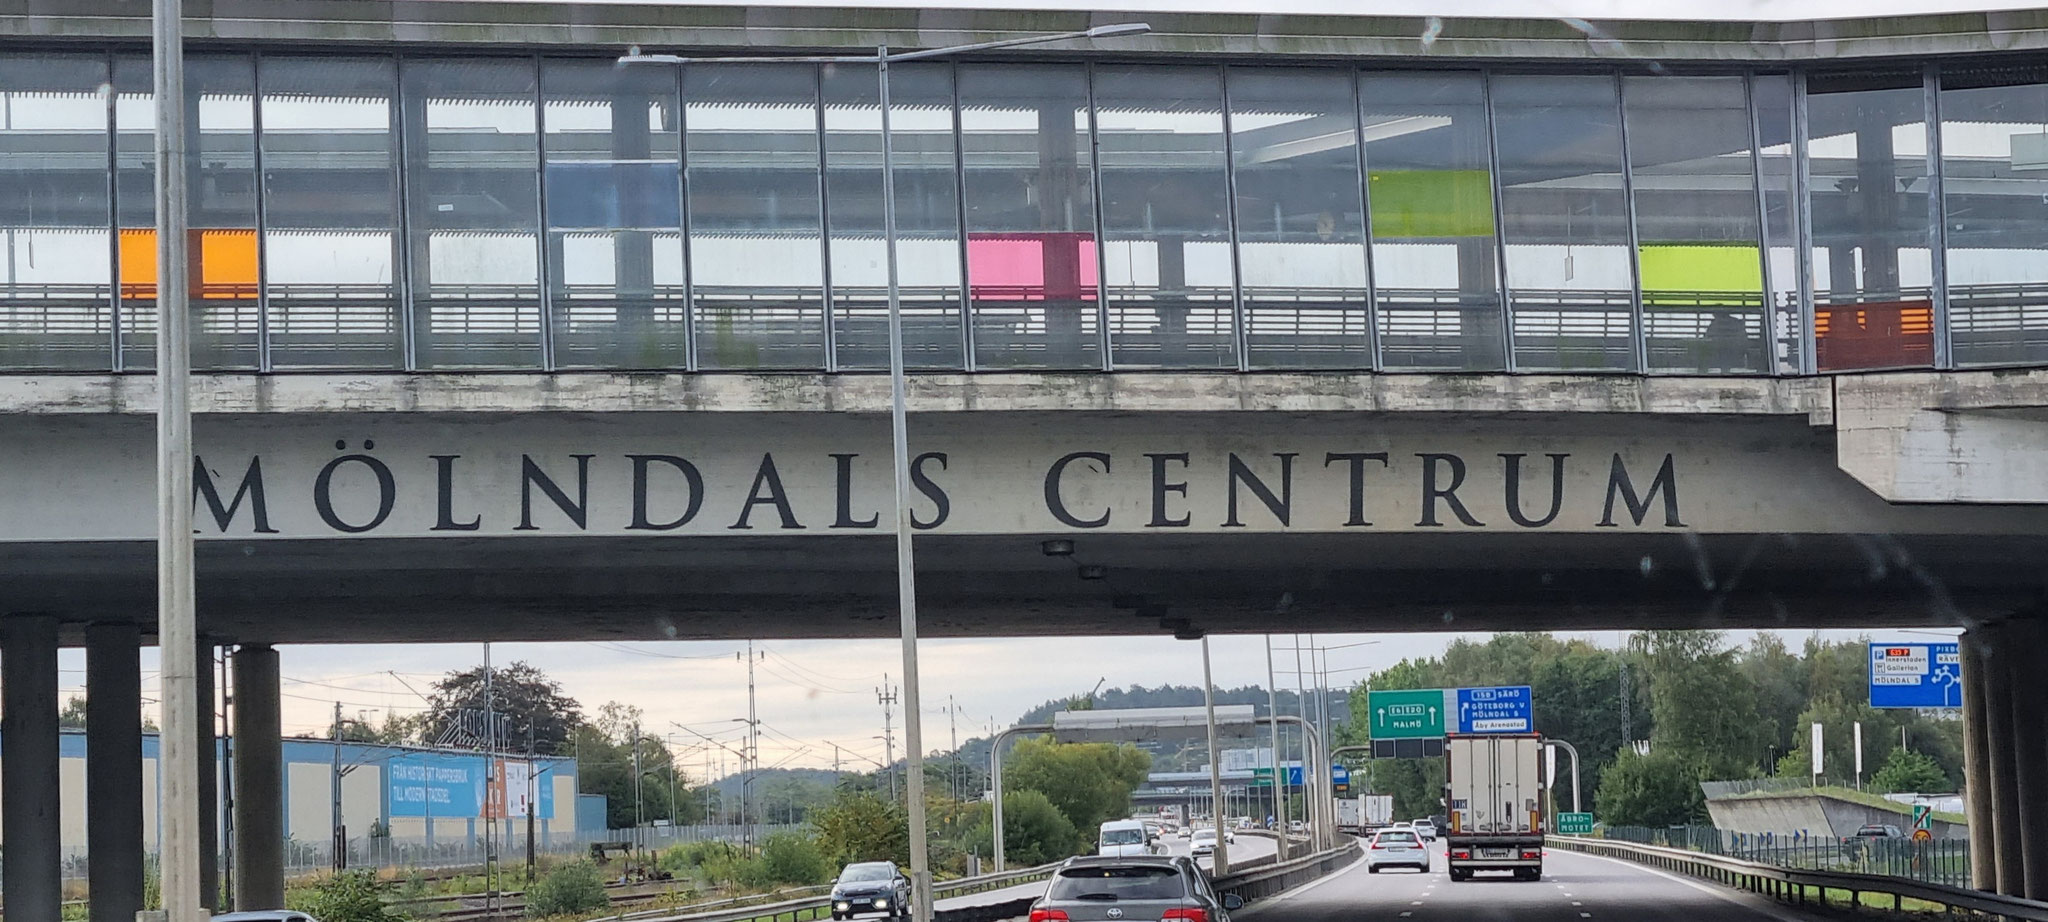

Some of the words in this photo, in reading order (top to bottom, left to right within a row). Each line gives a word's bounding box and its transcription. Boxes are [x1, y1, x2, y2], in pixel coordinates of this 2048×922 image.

[191, 439, 952, 534] MÖLNDALS
[1043, 450, 1689, 529] CENTRUM
[1887, 664, 1919, 672] Gallerian
[1874, 676, 1910, 684] MÖLNDAL
[1496, 689, 1520, 698] SÄRÖ
[1471, 702, 1515, 710] GÖTEBORG
[1471, 709, 1509, 718] MÖLNDAL
[1393, 720, 1422, 728] MALMÖ
[1474, 721, 1488, 729] Åby
[1490, 721, 1525, 729] Arenastad
[1560, 814, 1590, 822] ÅBRO-
[1561, 824, 1589, 832] MOTET
